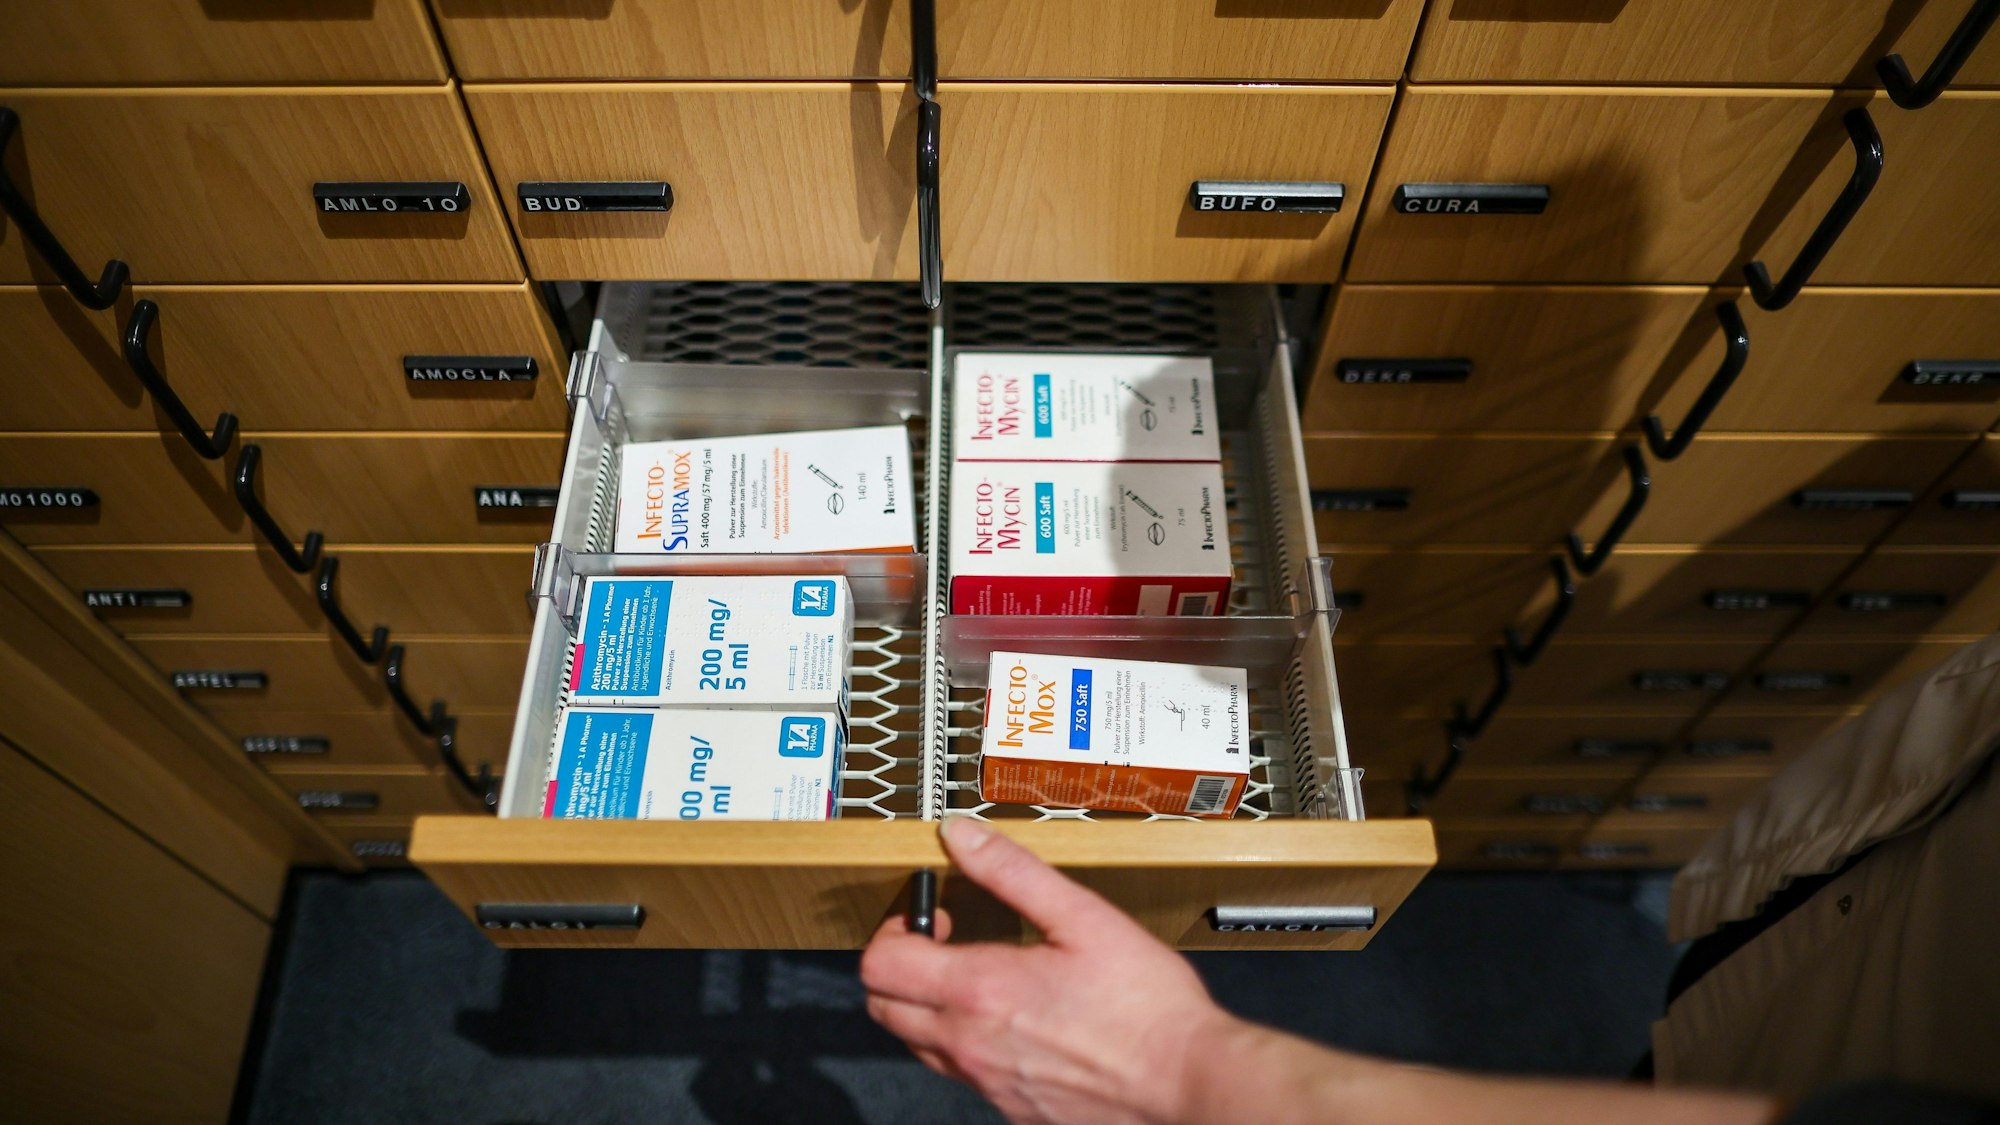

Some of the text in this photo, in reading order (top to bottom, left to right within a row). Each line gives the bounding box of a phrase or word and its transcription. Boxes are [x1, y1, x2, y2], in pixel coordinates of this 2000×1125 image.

[324, 198, 457, 211] AMLO 10
[526, 198, 581, 211] BUD
[1200, 197, 1277, 211] BUFO
[1405, 199, 1480, 213] CURA
[411, 367, 512, 381] AMOCLA
[1038, 385, 1049, 424] 600 Saft
[703, 449, 712, 458] ml
[730, 471, 738, 505] Herstellung
[858, 473, 867, 500] 140 ml
[479, 491, 523, 507] ANA
[638, 460, 664, 539] INFECTO-
[969, 477, 993, 554] INFECTO-
[1040, 496, 1051, 538] 600 Saft
[1177, 508, 1185, 526] 75 ml
[700, 532, 710, 548] Saft
[87, 592, 138, 607] ANTI
[642, 605, 648, 613] ab
[821, 586, 829, 610] PHARMA
[638, 615, 647, 635] Kinder
[621, 650, 632, 690] Suspension
[628, 598, 639, 633] Einnehmen
[641, 597, 658, 691] Jugendliche und Erwachsene
[699, 598, 730, 690] 200 mg/
[827, 635, 834, 643] N1
[591, 630, 608, 690] Azithromycin
[602, 635, 617, 690] 200 mg/5 ml
[612, 668, 620, 690] Pulver
[617, 615, 629, 654] Herstellung
[810, 646, 818, 679] Herstellung
[631, 648, 643, 690] Antibiotikum
[665, 650, 675, 690] Azithromycin
[726, 643, 748, 690] 5 ml
[801, 662, 810, 685] Flasche
[818, 682, 823, 690] 15
[1106, 691, 1112, 699] ml
[998, 659, 1027, 747] INFECTO-
[1076, 684, 1088, 731] 750 Saft
[1106, 701, 1114, 717] mg/5
[1115, 687, 1123, 721] Herstellung
[1201, 705, 1210, 729] 40 ml
[600, 732, 608, 750] einer
[619, 740, 627, 749] ab
[809, 725, 818, 751] PHARMA
[604, 733, 617, 771] Einnehmen
[614, 751, 625, 773] Kinder
[621, 732, 637, 789] und Erwachsene
[584, 772, 592, 784] ml
[592, 752, 606, 794] Herstellung
[611, 775, 620, 785] für
[679, 735, 713, 820] 00 mg/
[789, 774, 797, 794] Pulver
[816, 778, 821, 787] N1
[579, 787, 590, 812] mg/5
[590, 796, 598, 807] zur
[710, 786, 731, 813] ml
